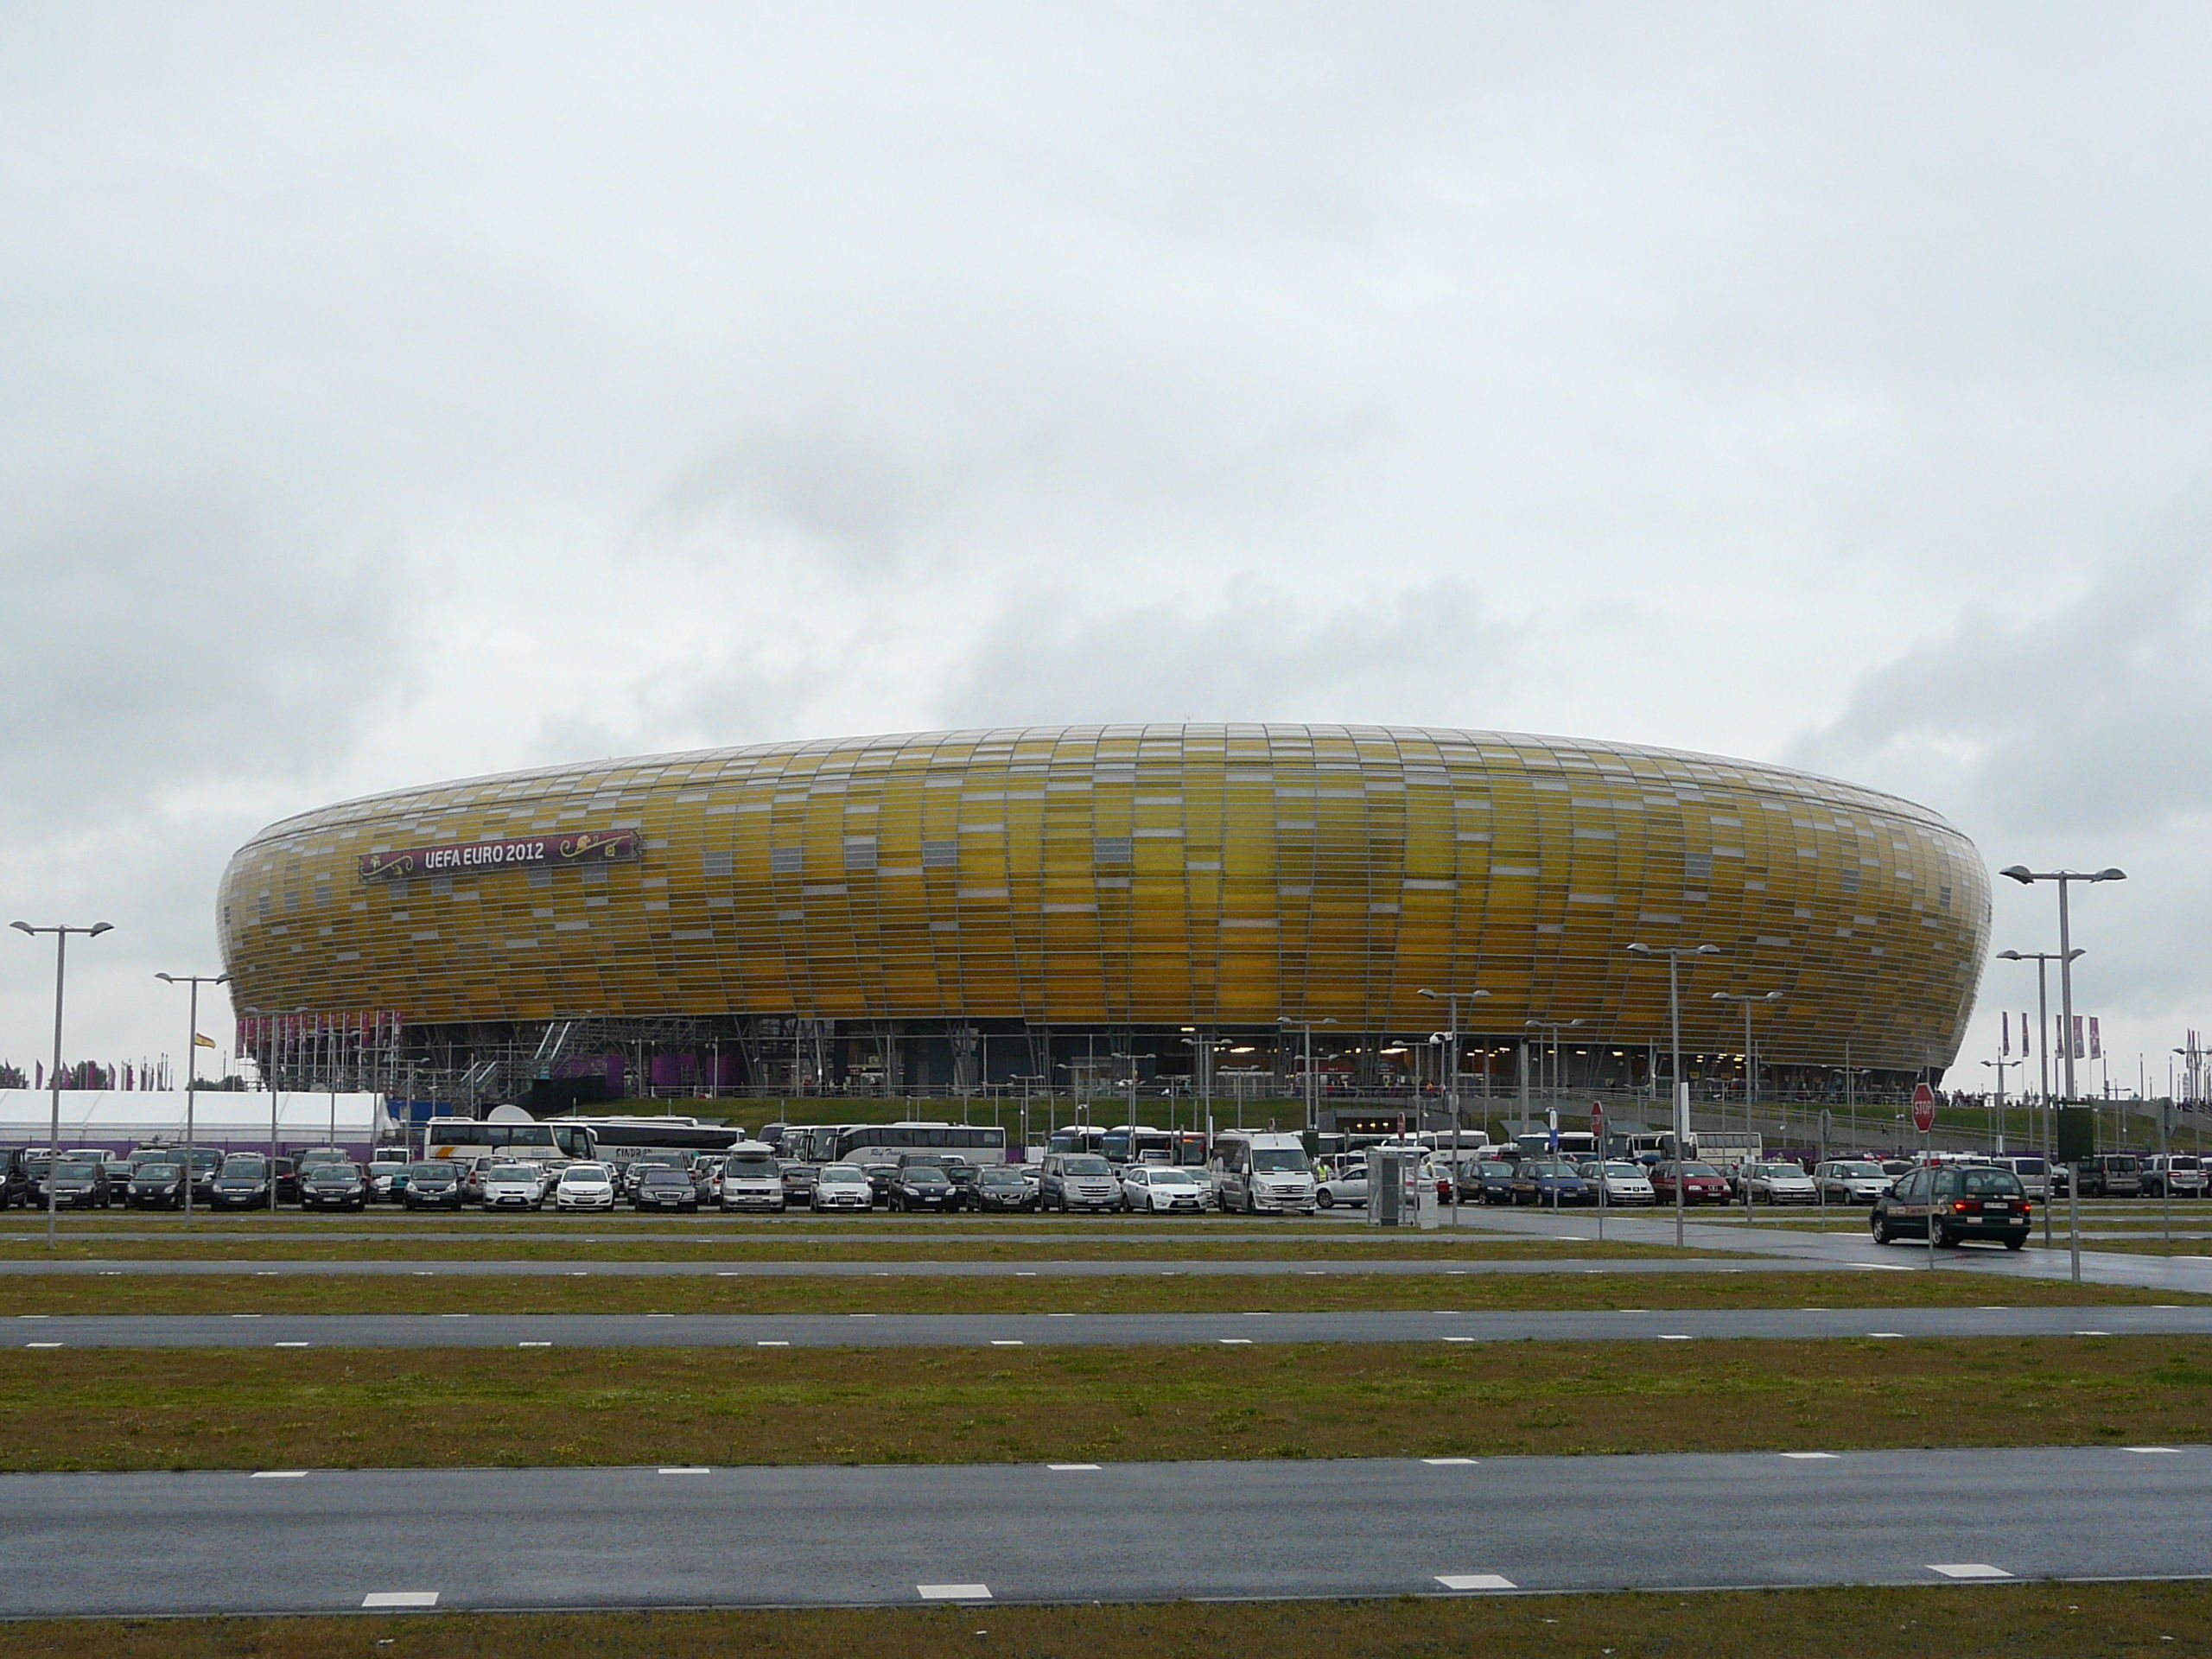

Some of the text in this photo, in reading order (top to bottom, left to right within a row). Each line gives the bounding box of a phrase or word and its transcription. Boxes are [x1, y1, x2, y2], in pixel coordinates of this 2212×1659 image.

[425, 842, 544, 868] UEFA EURO 2012
[1914, 1100, 1932, 1115] STOP
